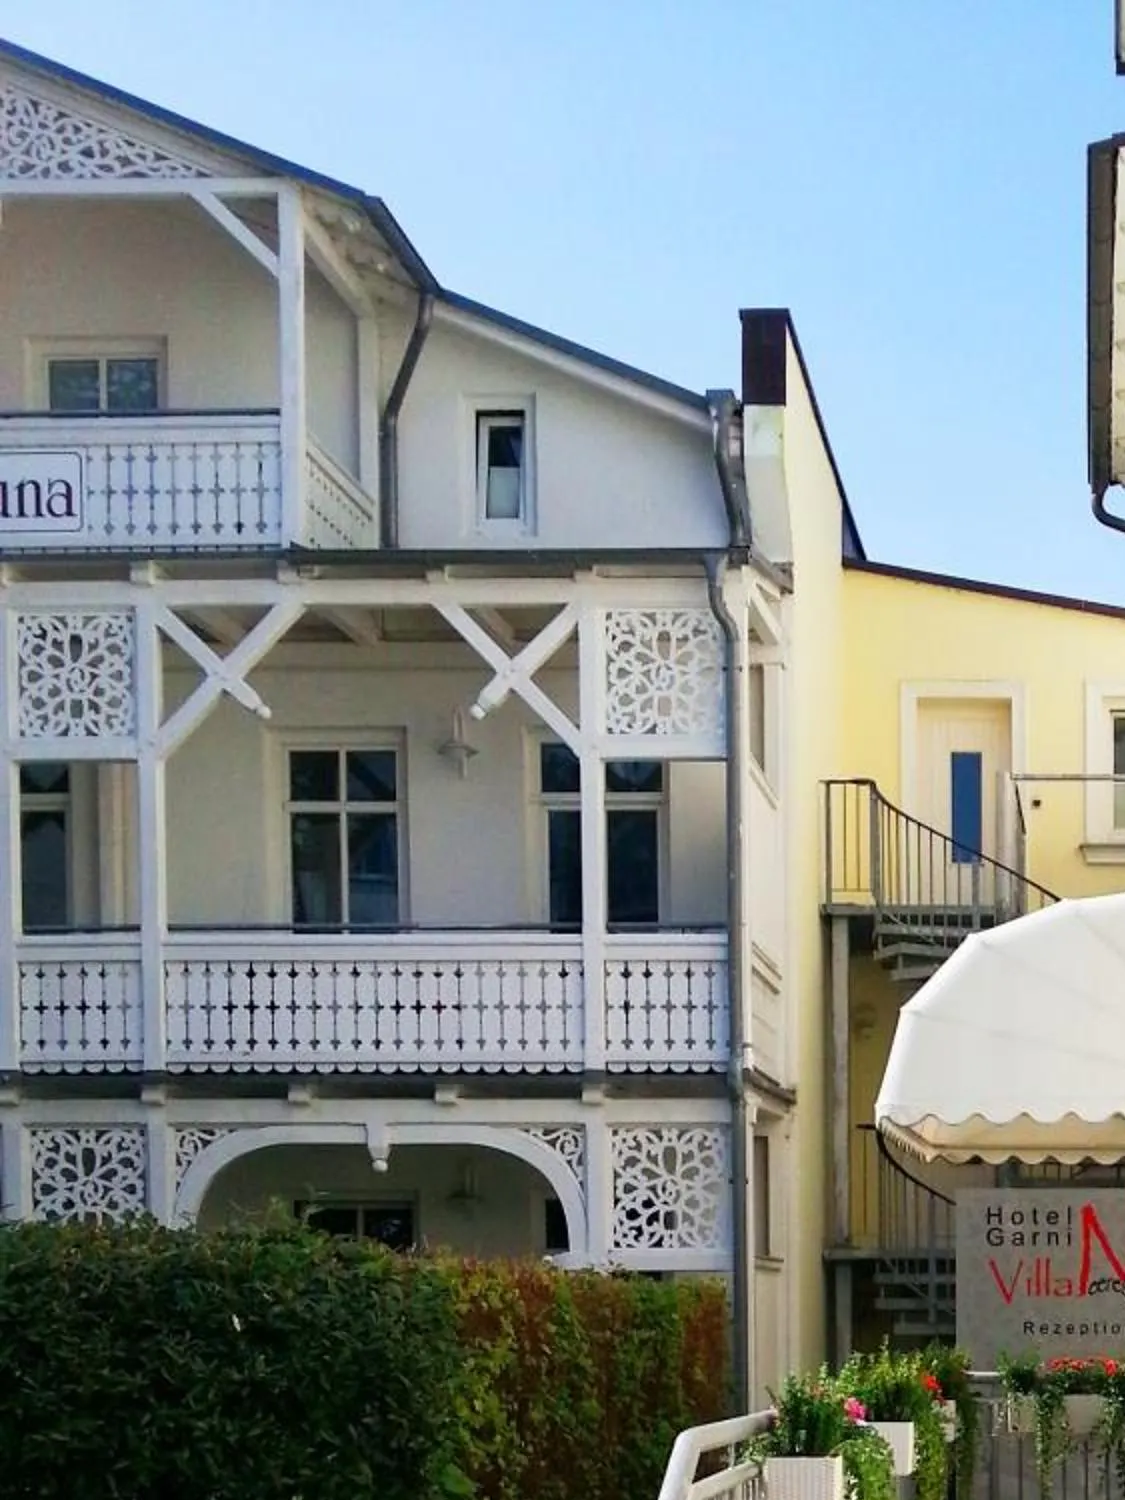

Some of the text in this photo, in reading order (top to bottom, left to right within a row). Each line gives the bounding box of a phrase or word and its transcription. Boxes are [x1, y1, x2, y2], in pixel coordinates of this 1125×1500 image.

[986, 1206, 1072, 1226] Hotel
[986, 1228, 1072, 1247] Garni
[988, 1256, 1073, 1304] Villa
